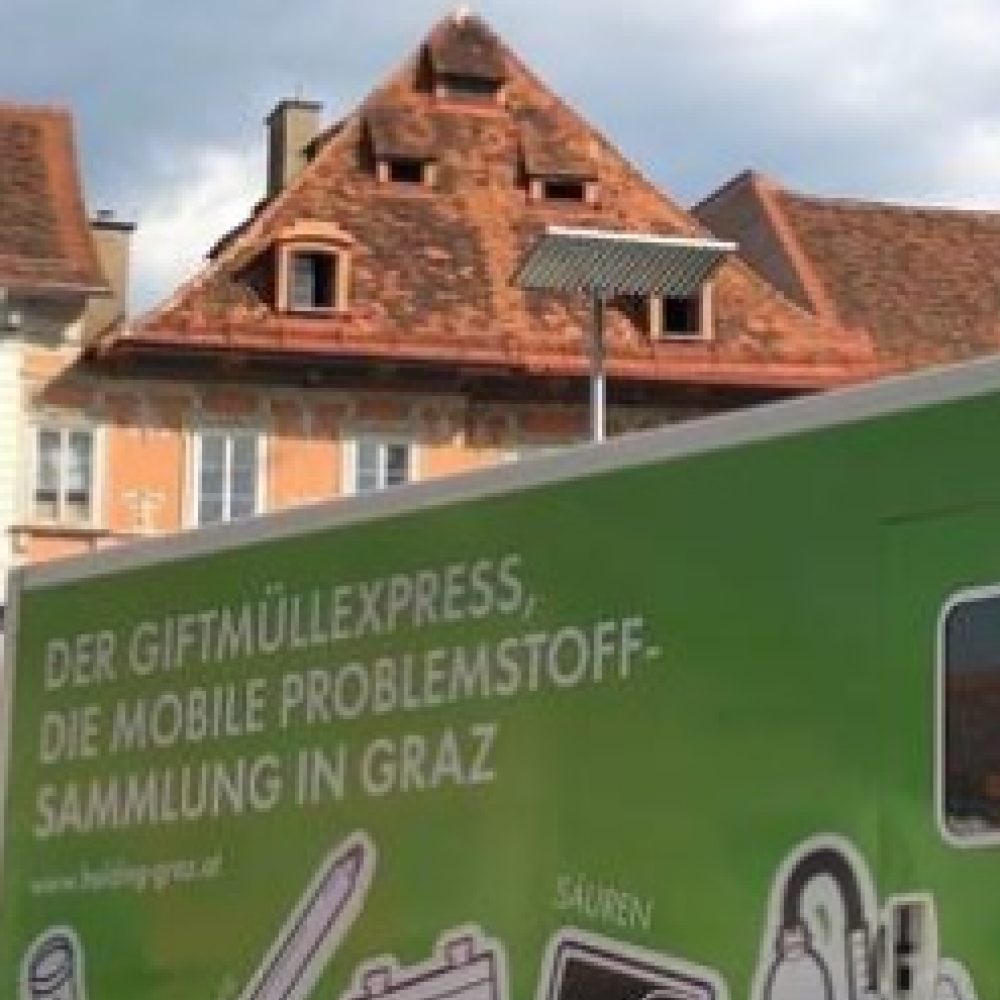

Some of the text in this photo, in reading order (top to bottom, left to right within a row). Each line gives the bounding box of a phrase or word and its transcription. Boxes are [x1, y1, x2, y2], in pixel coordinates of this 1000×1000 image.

[39, 616, 663, 764] DIE MOBILE PROBLEMSTOFF-
[44, 555, 537, 691] DER GIFTMÜLLEXPRESS,
[33, 722, 500, 839] SAMMLUNG IN GRAZ
